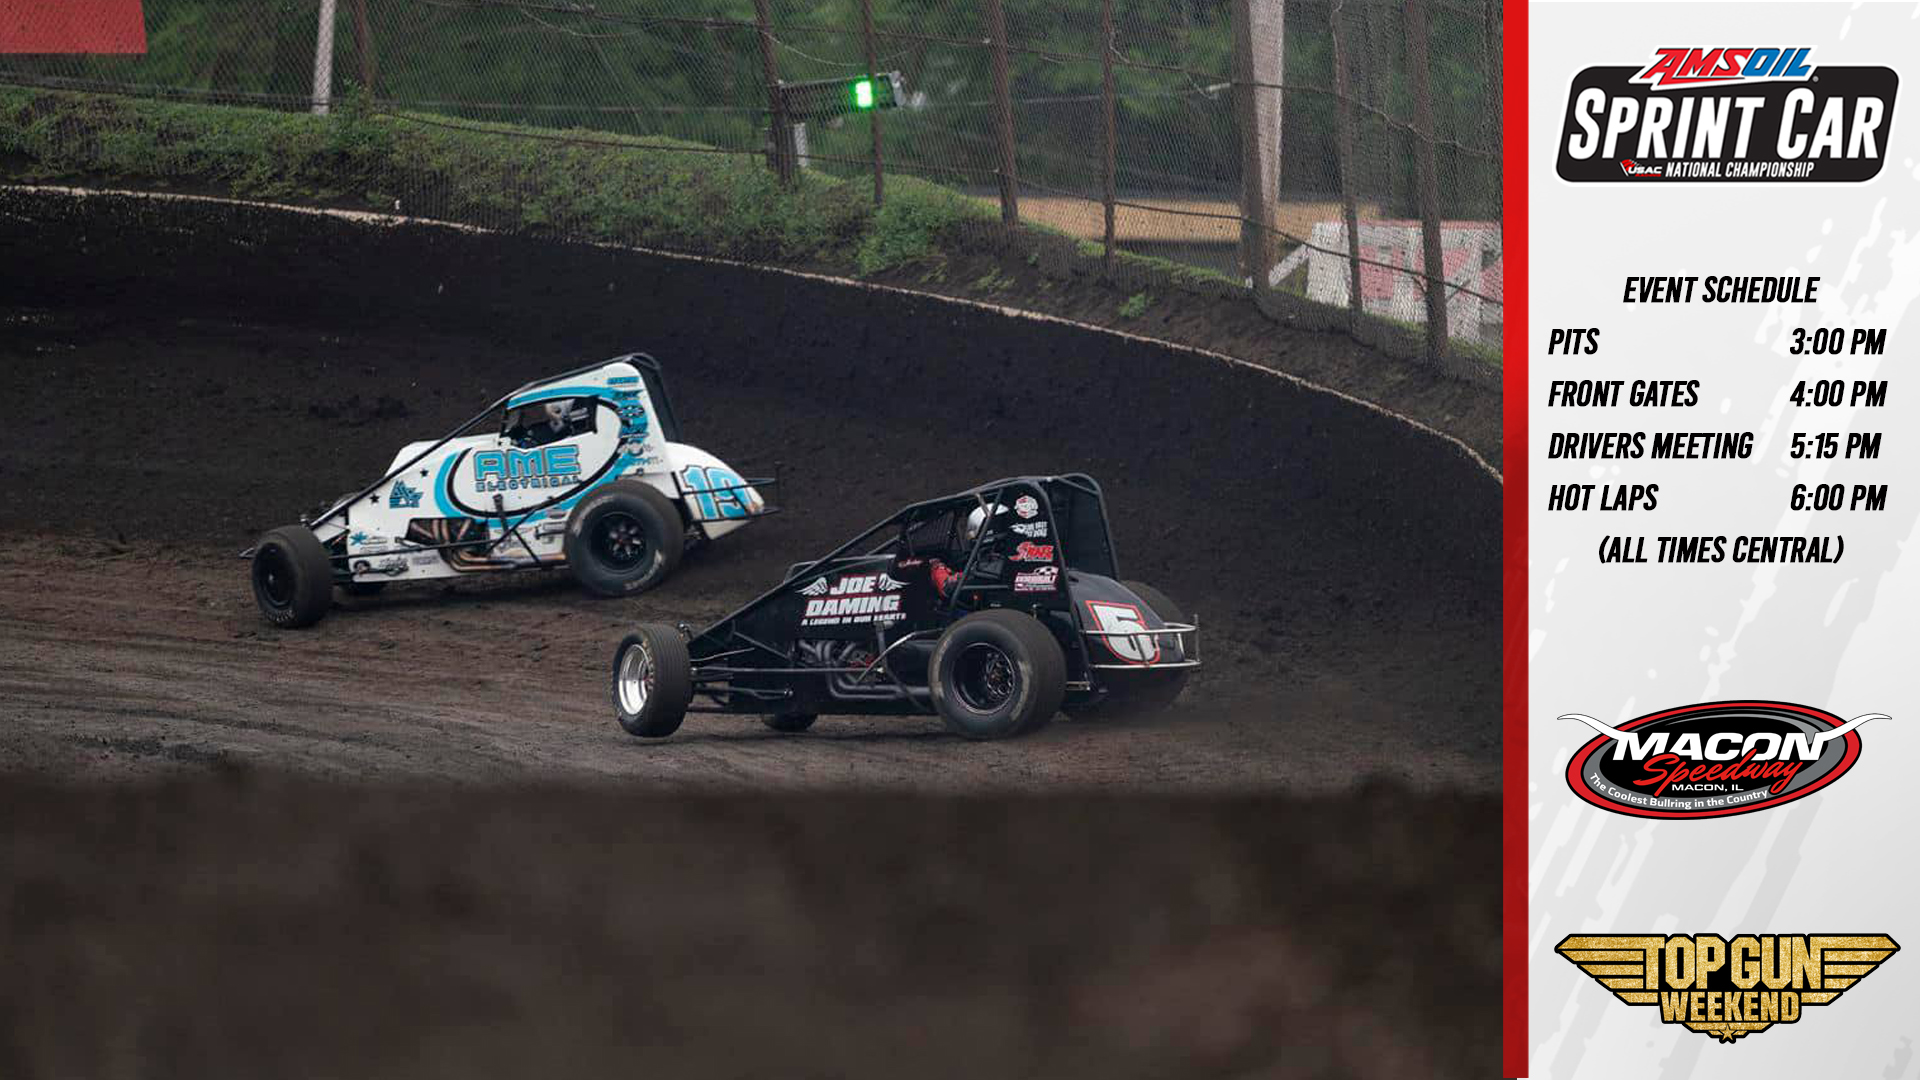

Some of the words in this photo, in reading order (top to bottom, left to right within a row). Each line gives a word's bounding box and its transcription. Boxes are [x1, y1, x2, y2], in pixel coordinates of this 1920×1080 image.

[473, 444, 581, 481] AME
[475, 475, 581, 492] ELECTRICAL
[680, 464, 752, 520] 19
[829, 576, 877, 595] JOE
[805, 594, 901, 617] DAMING
[801, 618, 808, 626] A
[809, 617, 840, 626] LEGEND
[842, 616, 852, 624] IN
[853, 615, 872, 623] OUR
[1085, 600, 1160, 665] 5
